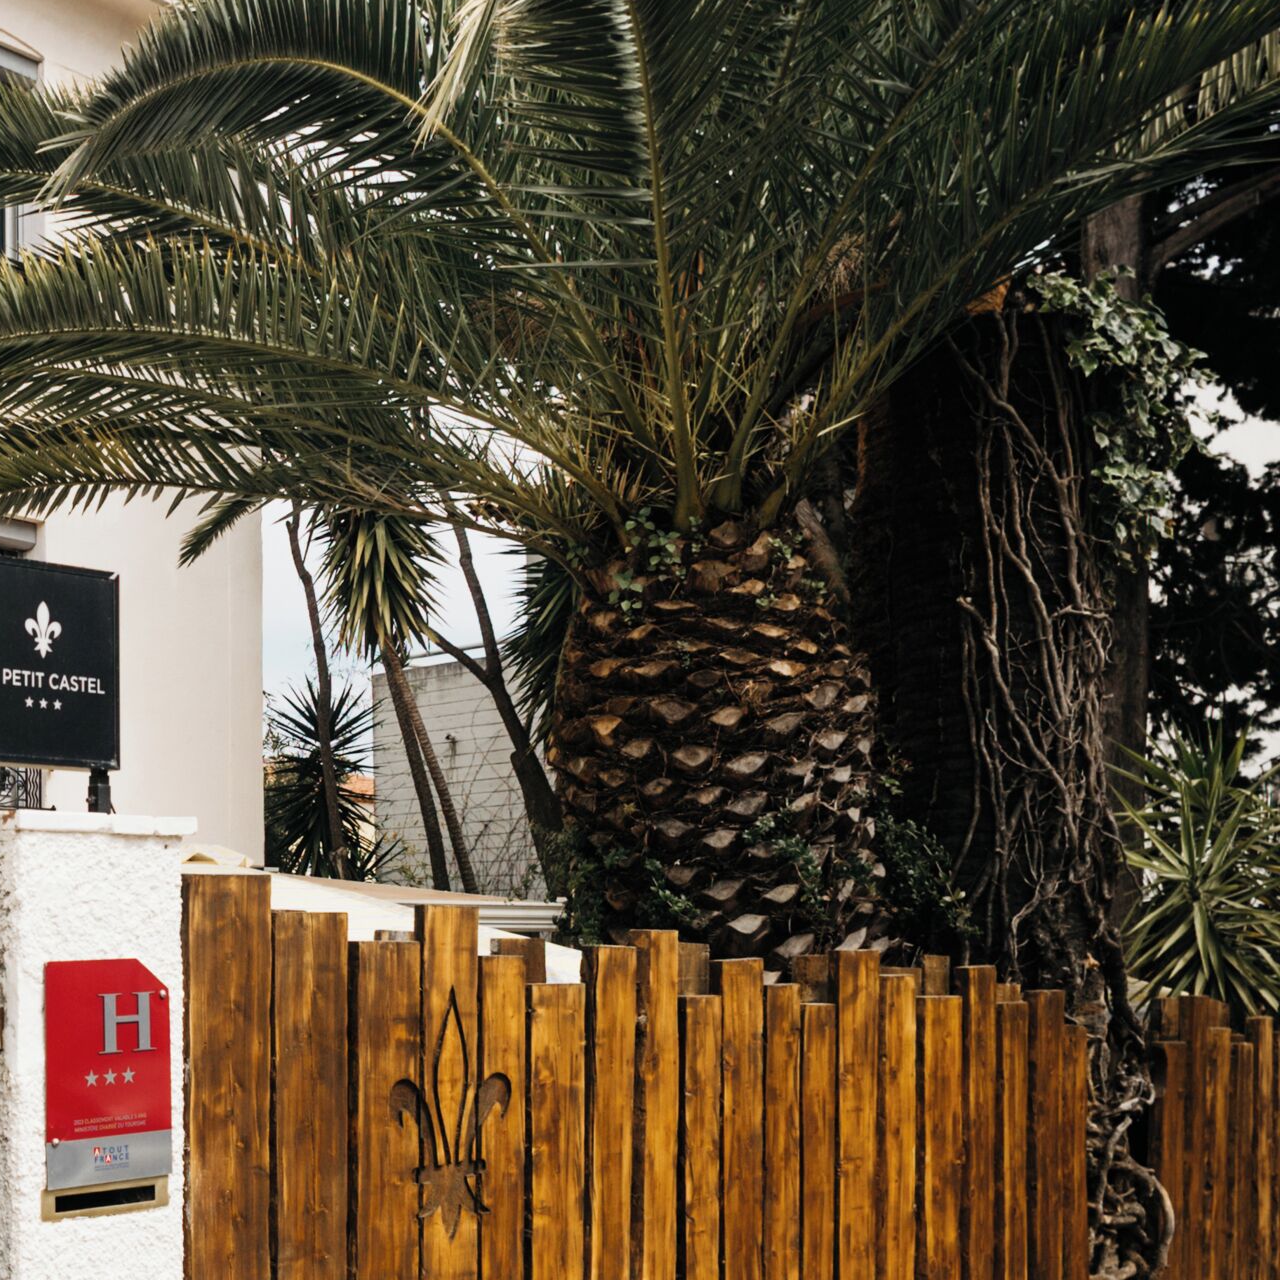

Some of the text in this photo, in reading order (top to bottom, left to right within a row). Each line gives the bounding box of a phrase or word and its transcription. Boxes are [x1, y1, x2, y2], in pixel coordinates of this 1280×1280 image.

[2, 668, 45, 688] PETIT
[48, 673, 106, 695] CASTEL
[96, 991, 158, 1055] H
[93, 1144, 129, 1156] ATOUT
[95, 1152, 129, 1165] FRANCE
